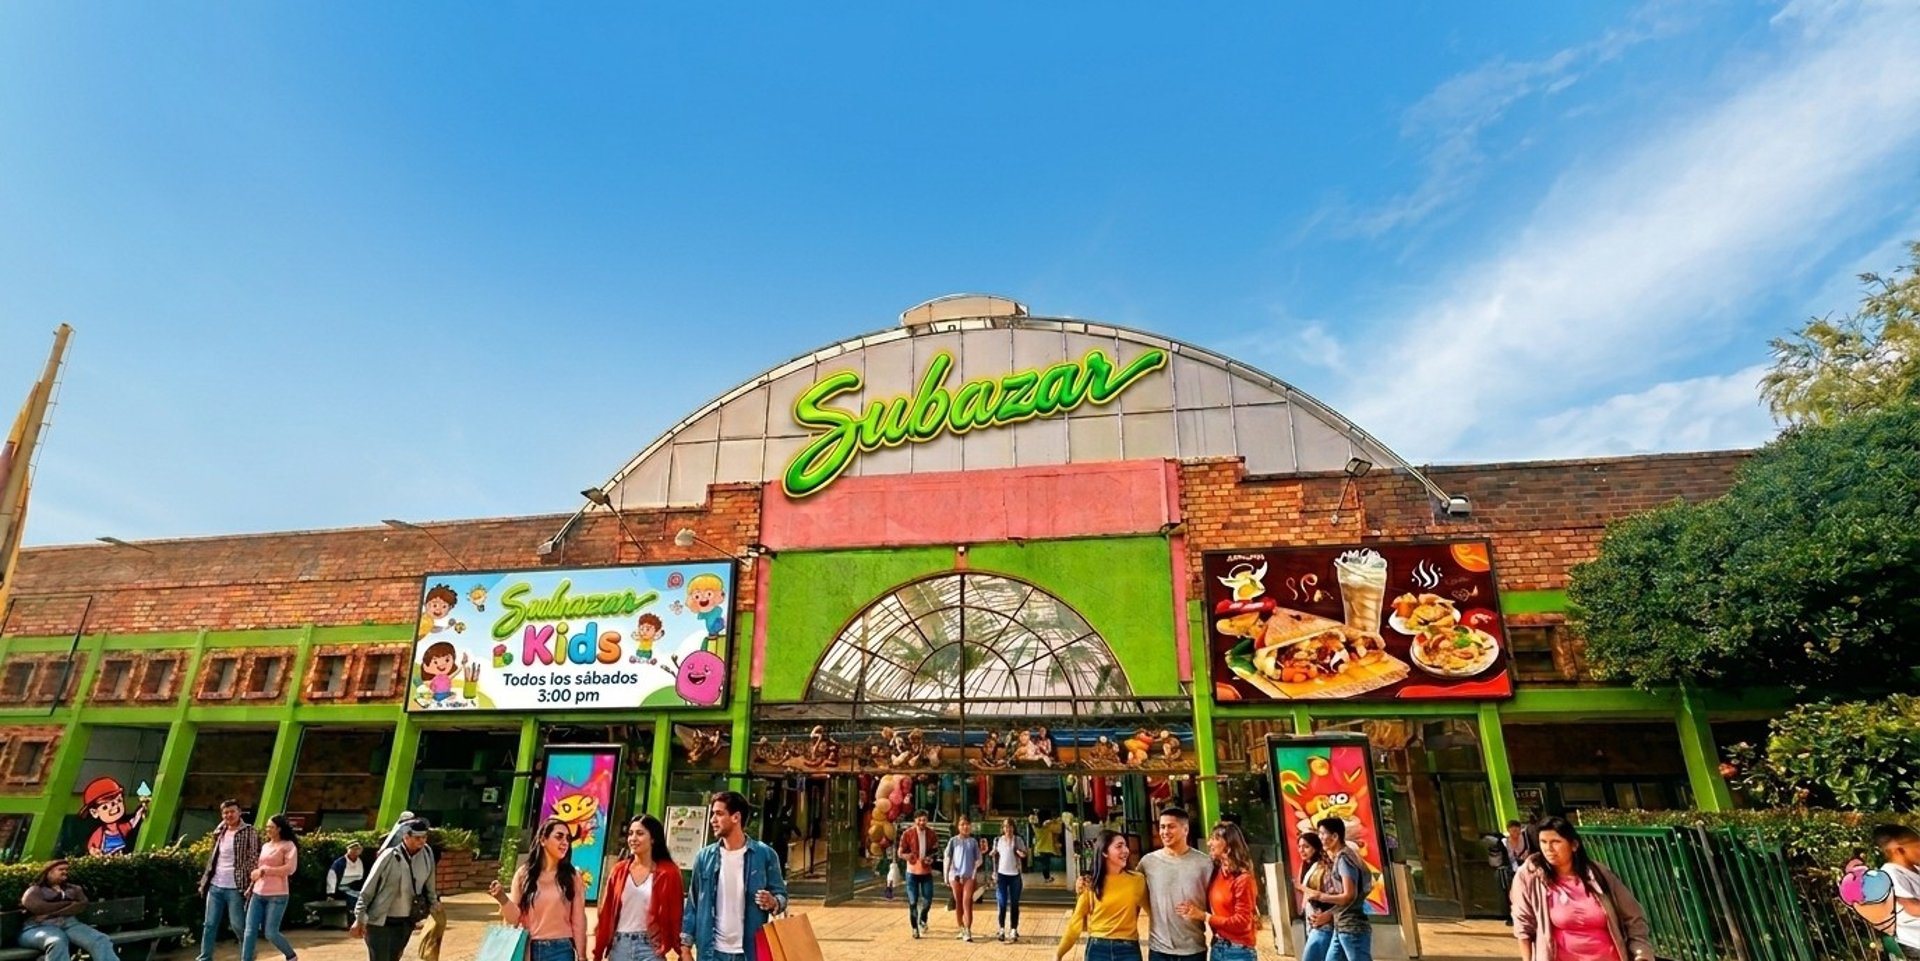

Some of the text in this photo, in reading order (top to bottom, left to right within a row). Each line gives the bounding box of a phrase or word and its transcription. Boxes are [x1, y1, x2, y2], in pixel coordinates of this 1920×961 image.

[783, 350, 1167, 498] Subazar
[522, 622, 621, 666] Kids
[503, 673, 546, 686] Todos
[575, 670, 638, 685] sábados
[537, 689, 600, 704] 3:00 pm
